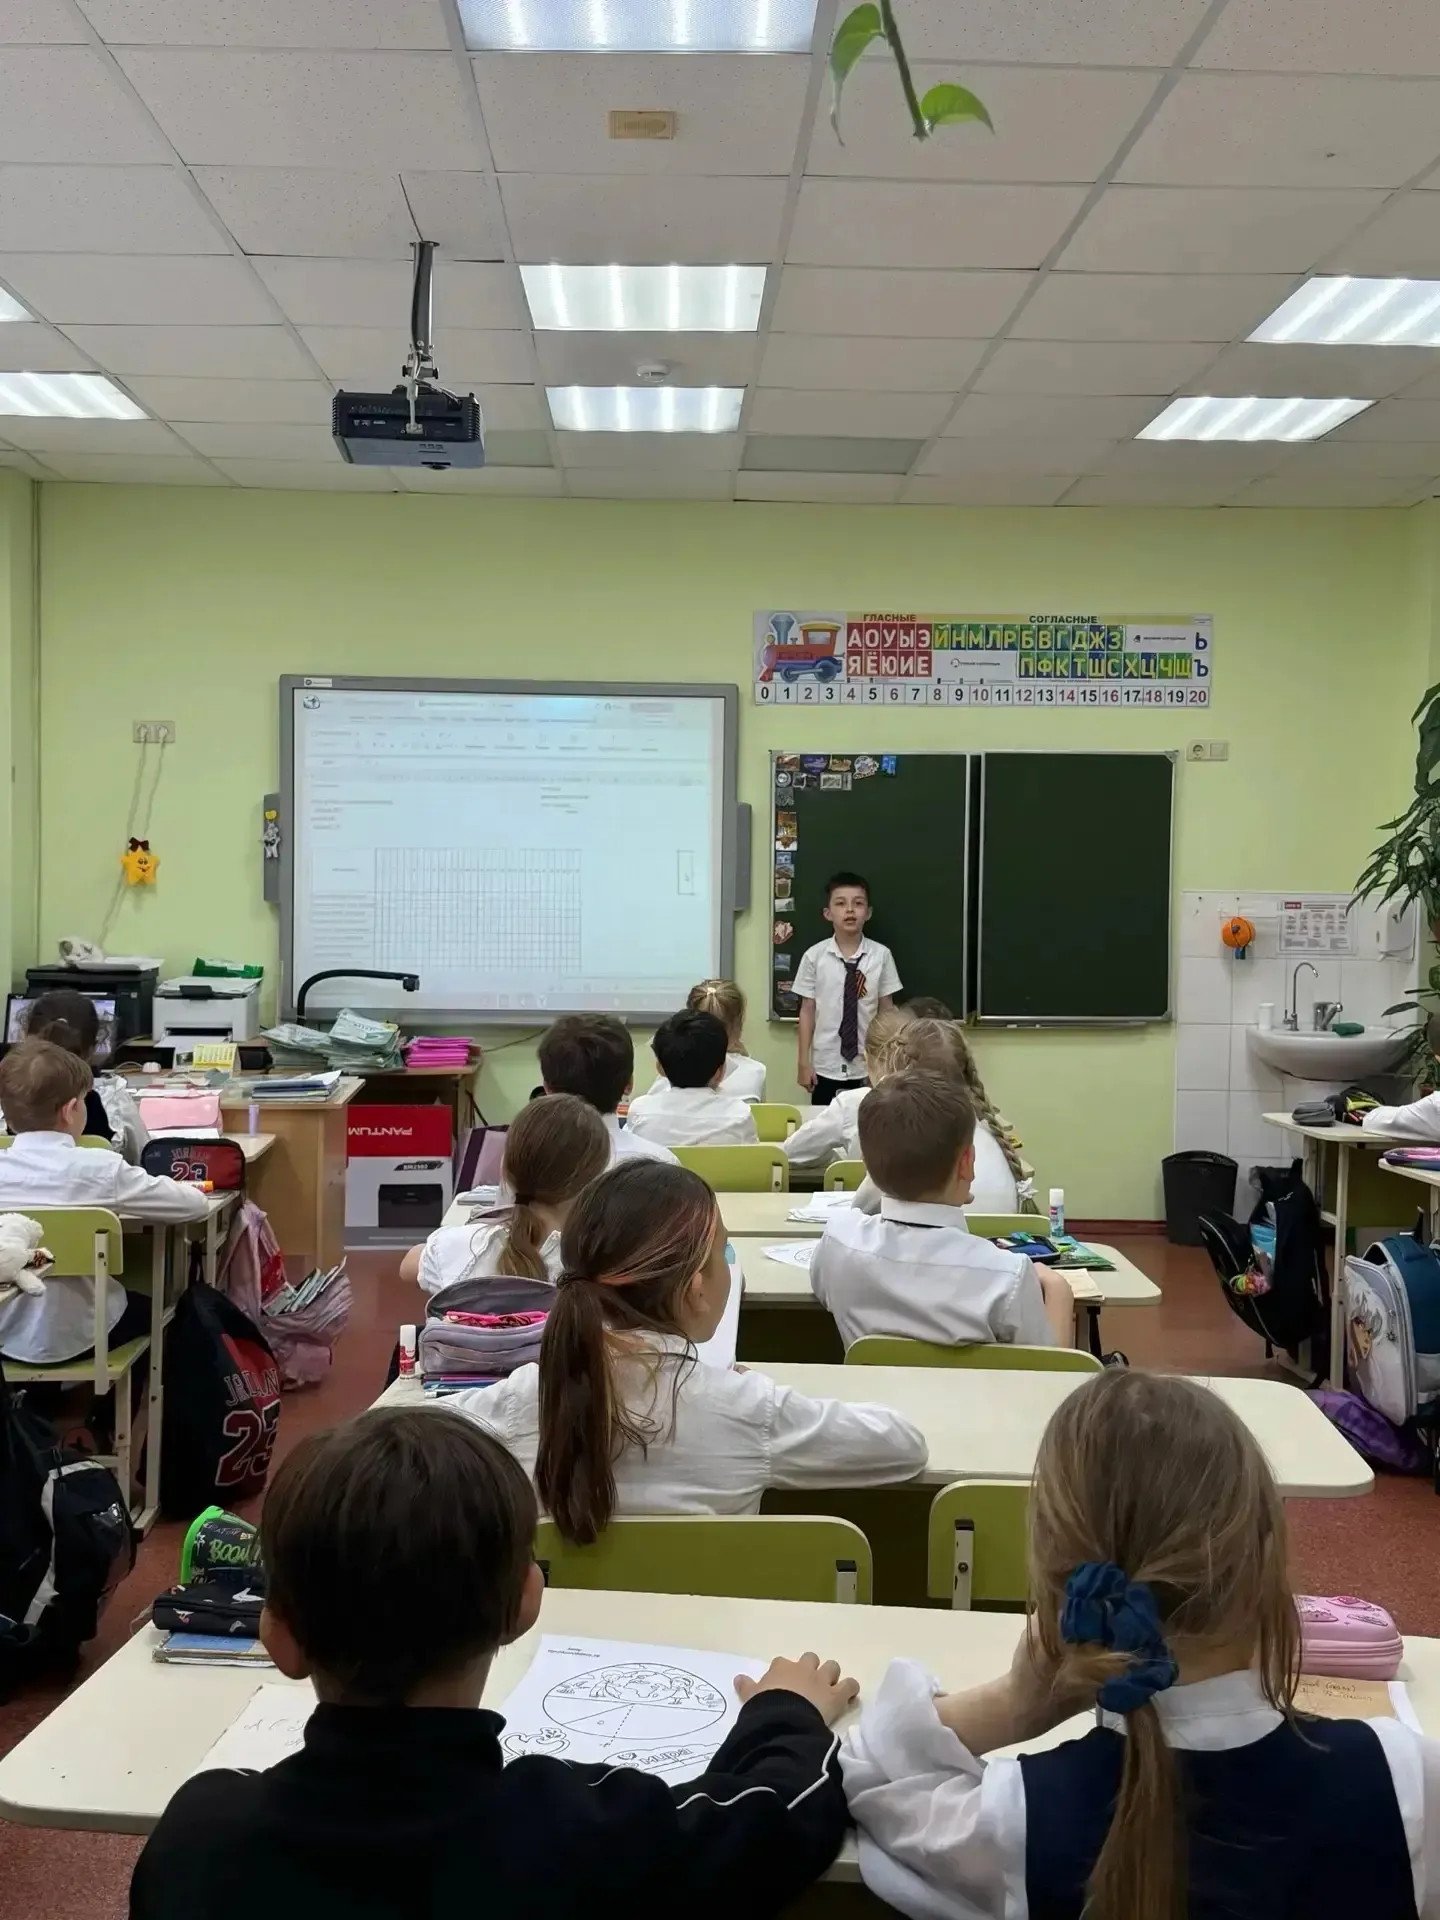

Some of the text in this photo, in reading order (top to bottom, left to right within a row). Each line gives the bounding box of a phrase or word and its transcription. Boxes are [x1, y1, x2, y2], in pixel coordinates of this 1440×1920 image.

[863, 613, 917, 622] ГЛАСНЫЕ
[1029, 615, 1098, 624] СОГЛАСНЫЕ
[761, 686, 1207, 702] 0 1 2 3 4 5 6 7 8 9 10 11 12 13 14 15 16 17 18 19 20
[348, 1127, 412, 1136] PANTUM
[171, 1161, 208, 1181] 23
